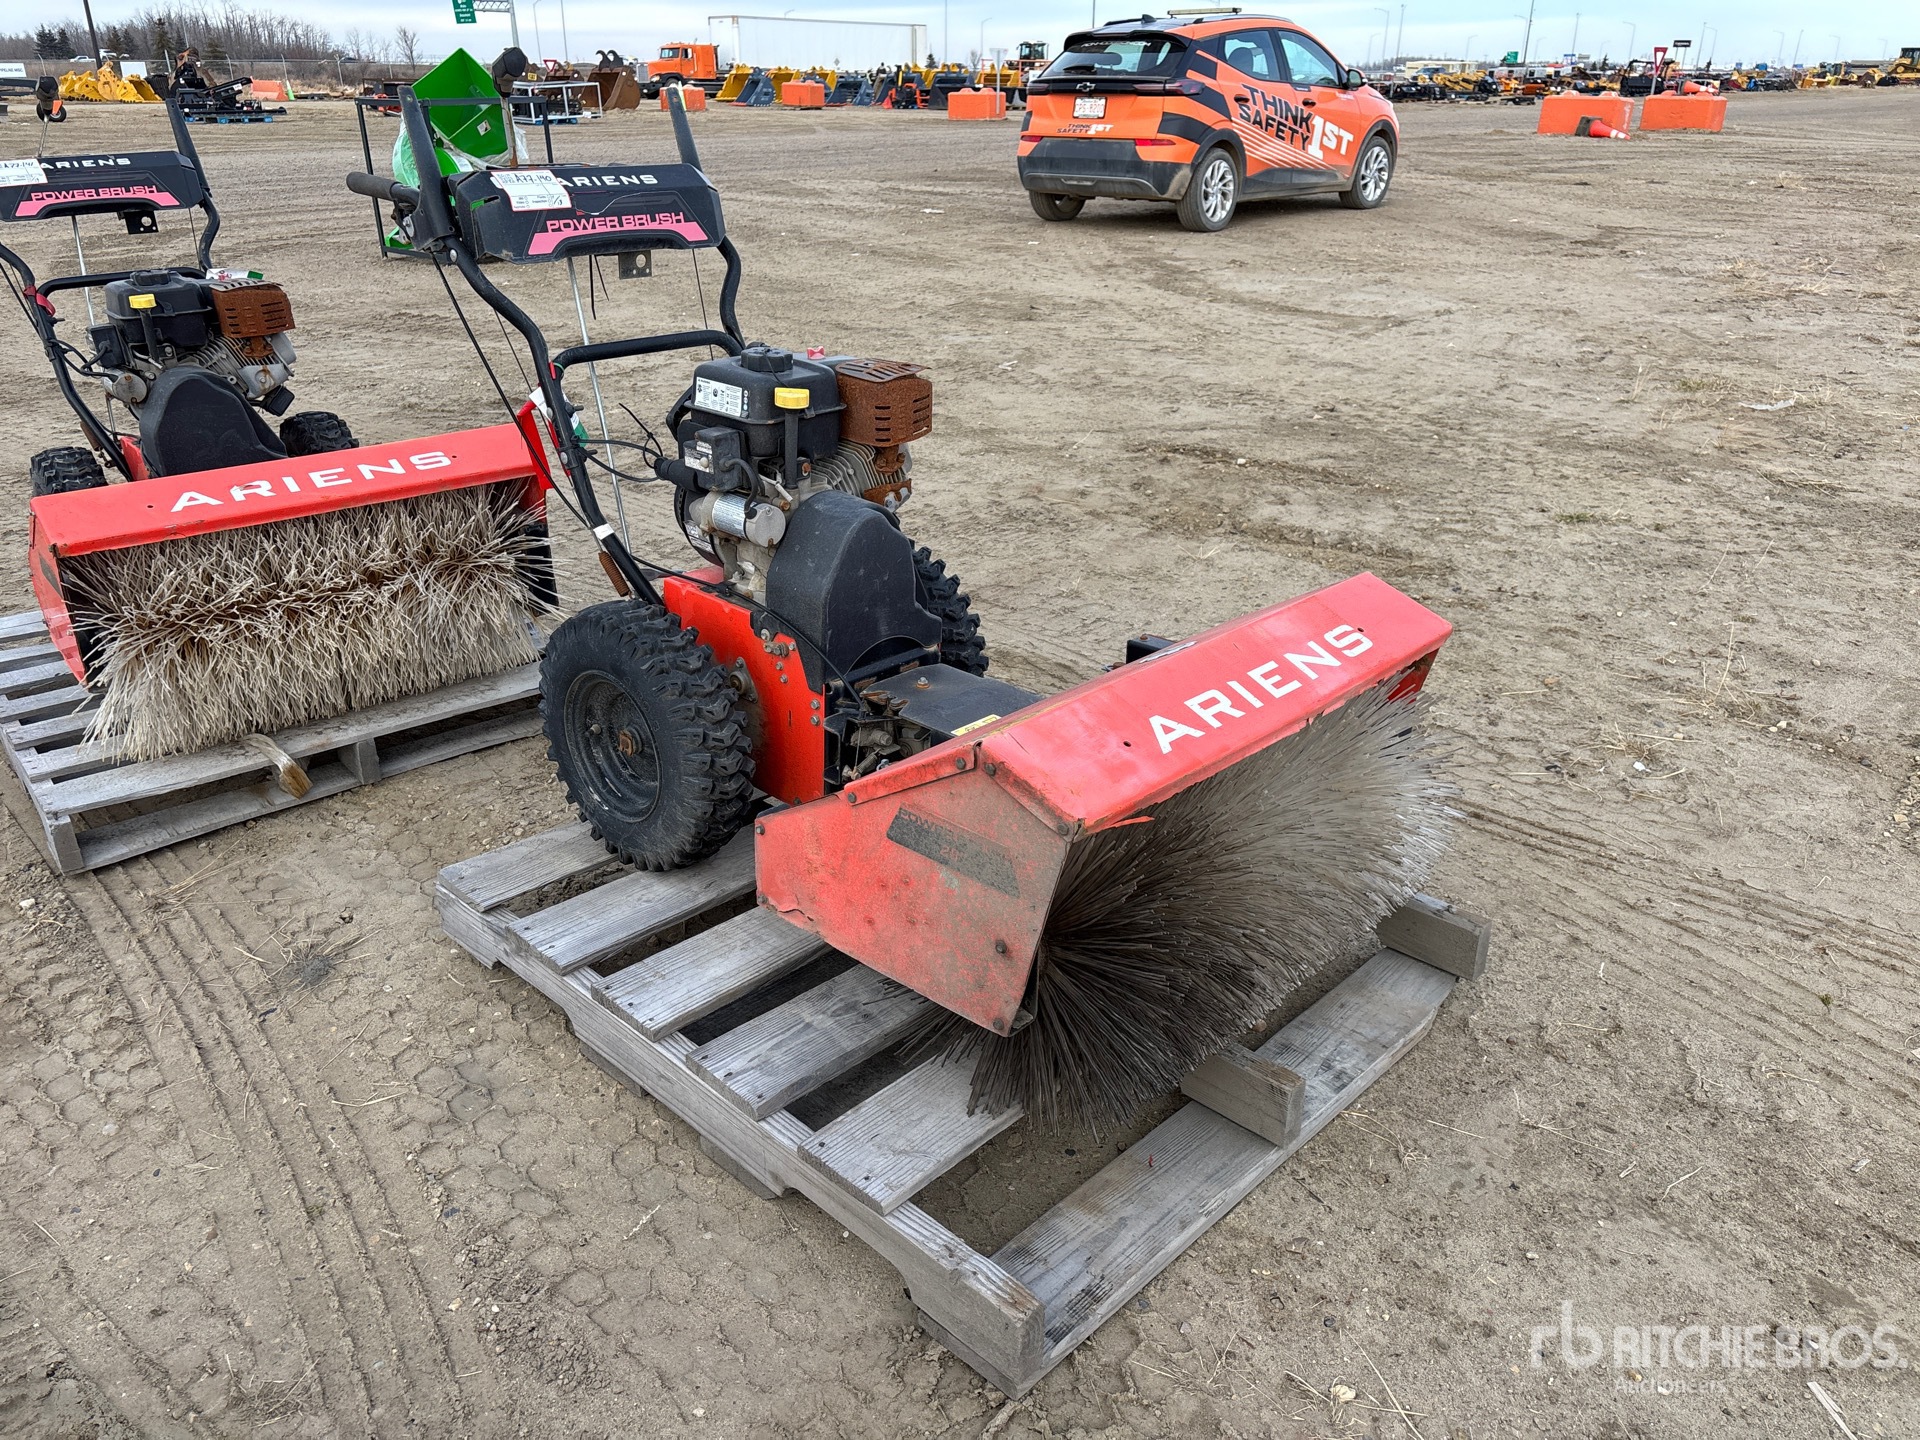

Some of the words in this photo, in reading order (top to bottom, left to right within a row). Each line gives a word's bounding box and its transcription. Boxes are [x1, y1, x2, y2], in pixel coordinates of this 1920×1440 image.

[1241, 83, 1314, 133] THINK
[1087, 124, 1114, 134] 1ST
[1239, 103, 1310, 151] SAFETY
[1307, 115, 1354, 160] 1ST
[40, 157, 131, 170] ARIENS
[557, 174, 659, 188] ARIENS
[31, 187, 97, 202] POWER
[99, 184, 157, 199] BRUSH
[546, 216, 619, 233] POWER
[622, 212, 685, 230] BRUSH
[170, 450, 452, 513] ARIENS
[1148, 624, 1374, 754] ARIENS
